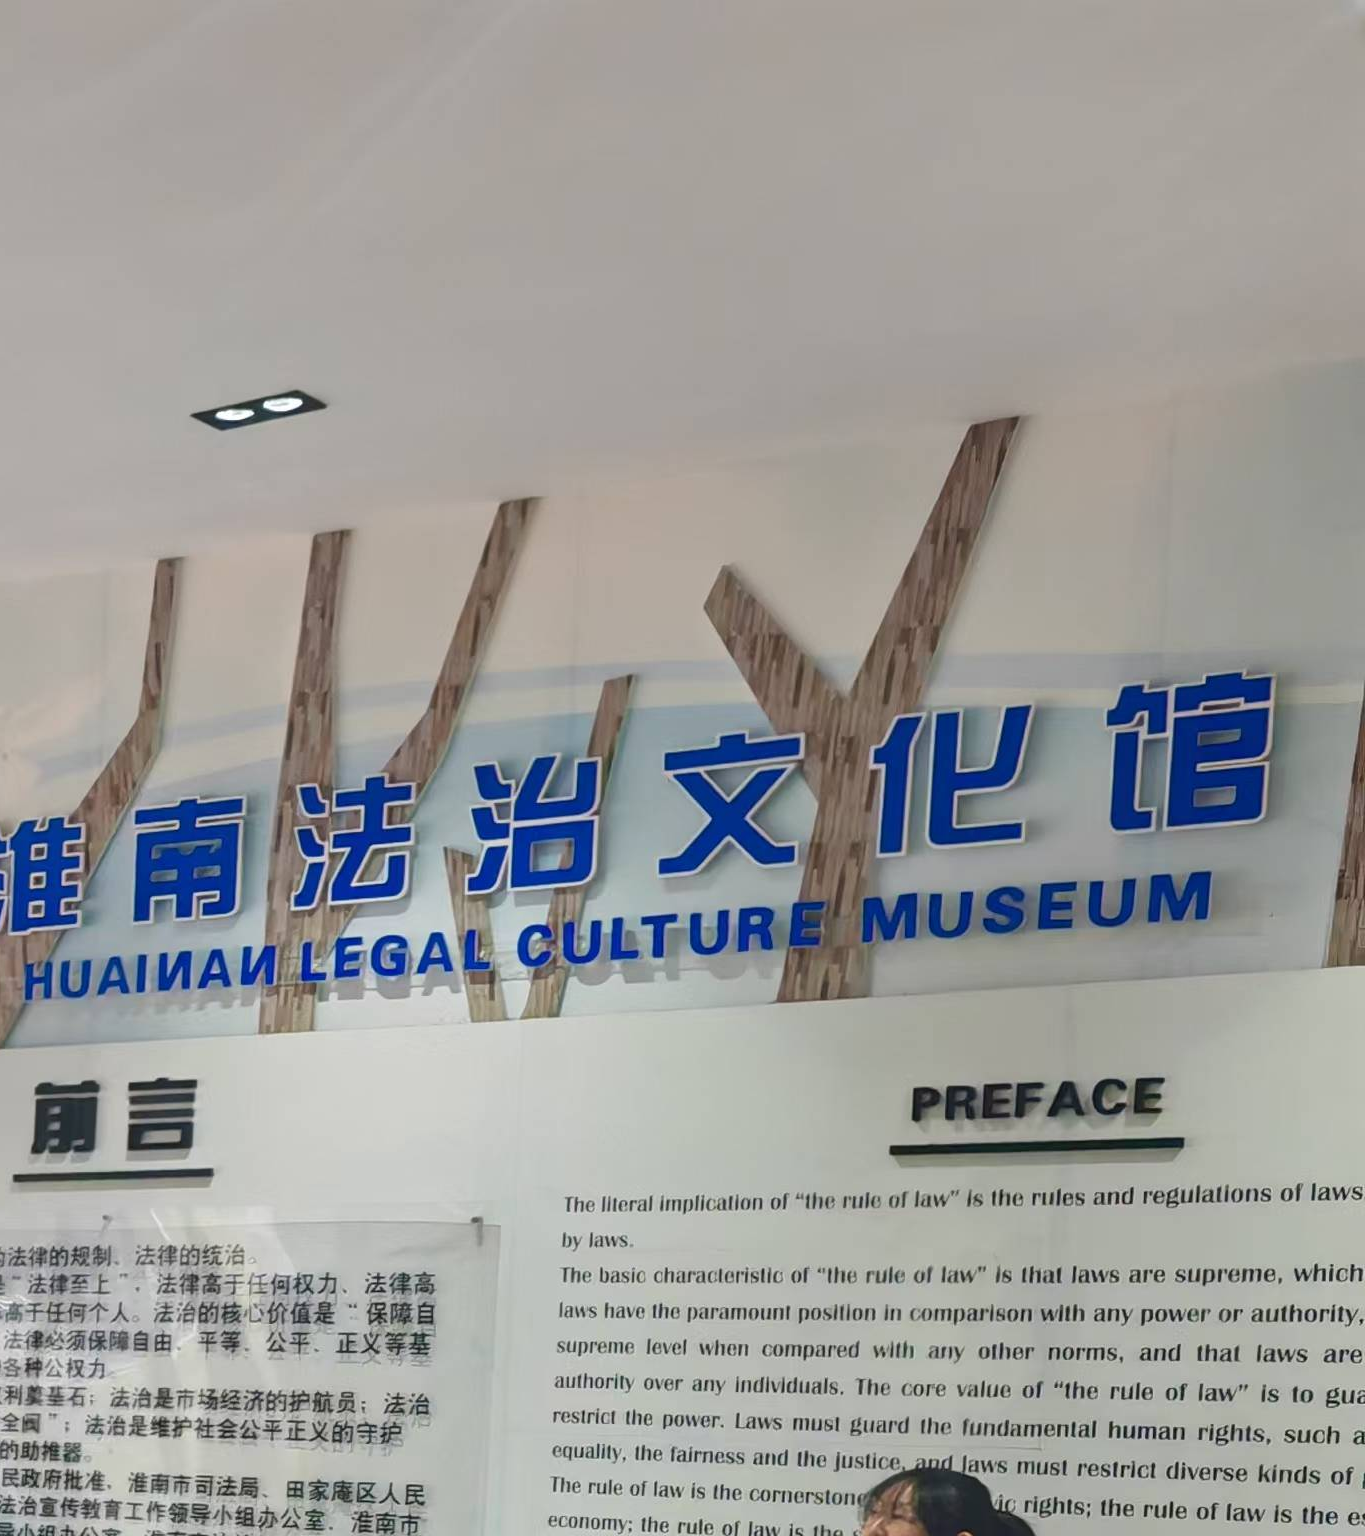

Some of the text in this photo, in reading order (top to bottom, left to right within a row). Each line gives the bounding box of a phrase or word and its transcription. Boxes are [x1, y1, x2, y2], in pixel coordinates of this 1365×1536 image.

[301, 929, 490, 981] LEGAL
[517, 900, 828, 969] CULTURE
[861, 870, 1213, 944] MUSEUM
[910, 1076, 1166, 1122] PREFACE
[31, 1077, 198, 1154] 前言
[564, 1195, 596, 1214] The
[601, 1194, 654, 1213] literal
[659, 1193, 764, 1216] implication
[770, 1192, 790, 1211] of
[842, 1191, 882, 1210] rule
[888, 1190, 910, 1209] of
[966, 1188, 984, 1208] is
[991, 1188, 1024, 1208] the
[1031, 1187, 1086, 1207] rules
[1092, 1186, 1135, 1206] and
[1142, 1183, 1272, 1209] regulations
[1279, 1182, 1305, 1203] of
[1310, 1182, 1364, 1202] laws
[561, 1231, 634, 1253] by laws.
[559, 1266, 593, 1284] The
[598, 1266, 647, 1284] basic
[653, 1266, 784, 1285] characteristic
[790, 1265, 811, 1285] of
[865, 1265, 906, 1285] rule
[912, 1265, 934, 1285] of
[995, 1264, 1013, 1284] is
[1021, 1265, 1063, 1285] that
[1071, 1264, 1121, 1285] laws
[1128, 1268, 1166, 1284] are
[1174, 1267, 1283, 1288] supreme,
[1293, 1262, 1364, 1283] which
[558, 1301, 1365, 1328] laws have the paramount position in comparison with any power or authority,
[553, 1372, 635, 1394] authority
[643, 1377, 685, 1392] over
[691, 1378, 727, 1397] any
[734, 1375, 845, 1396] individuals.
[854, 1377, 891, 1397] The
[900, 1382, 947, 1398] core
[956, 1379, 1012, 1399] value
[1021, 1380, 1045, 1399] of
[1109, 1381, 1154, 1401] rule
[1164, 1382, 1189, 1402] of
[1260, 1383, 1280, 1404] is
[1291, 1385, 1315, 1404] to
[552, 1407, 1341, 1447] restrict the power. Laws must guard the fundamental human rights, such
[551, 1442, 627, 1465] equality,
[634, 1444, 664, 1462] the
[670, 1445, 746, 1465] fairness
[752, 1448, 789, 1467] and
[796, 1449, 828, 1469] the
[962, 1454, 1355, 1486] laws must restrict diverse kinds of
[549, 1475, 743, 1502] The rule of law is the
[547, 1515, 633, 1535] economy;
[640, 1515, 670, 1534] the
[677, 1518, 715, 1536] rule
[1024, 1495, 1339, 1526] rights; the rule of law is the
